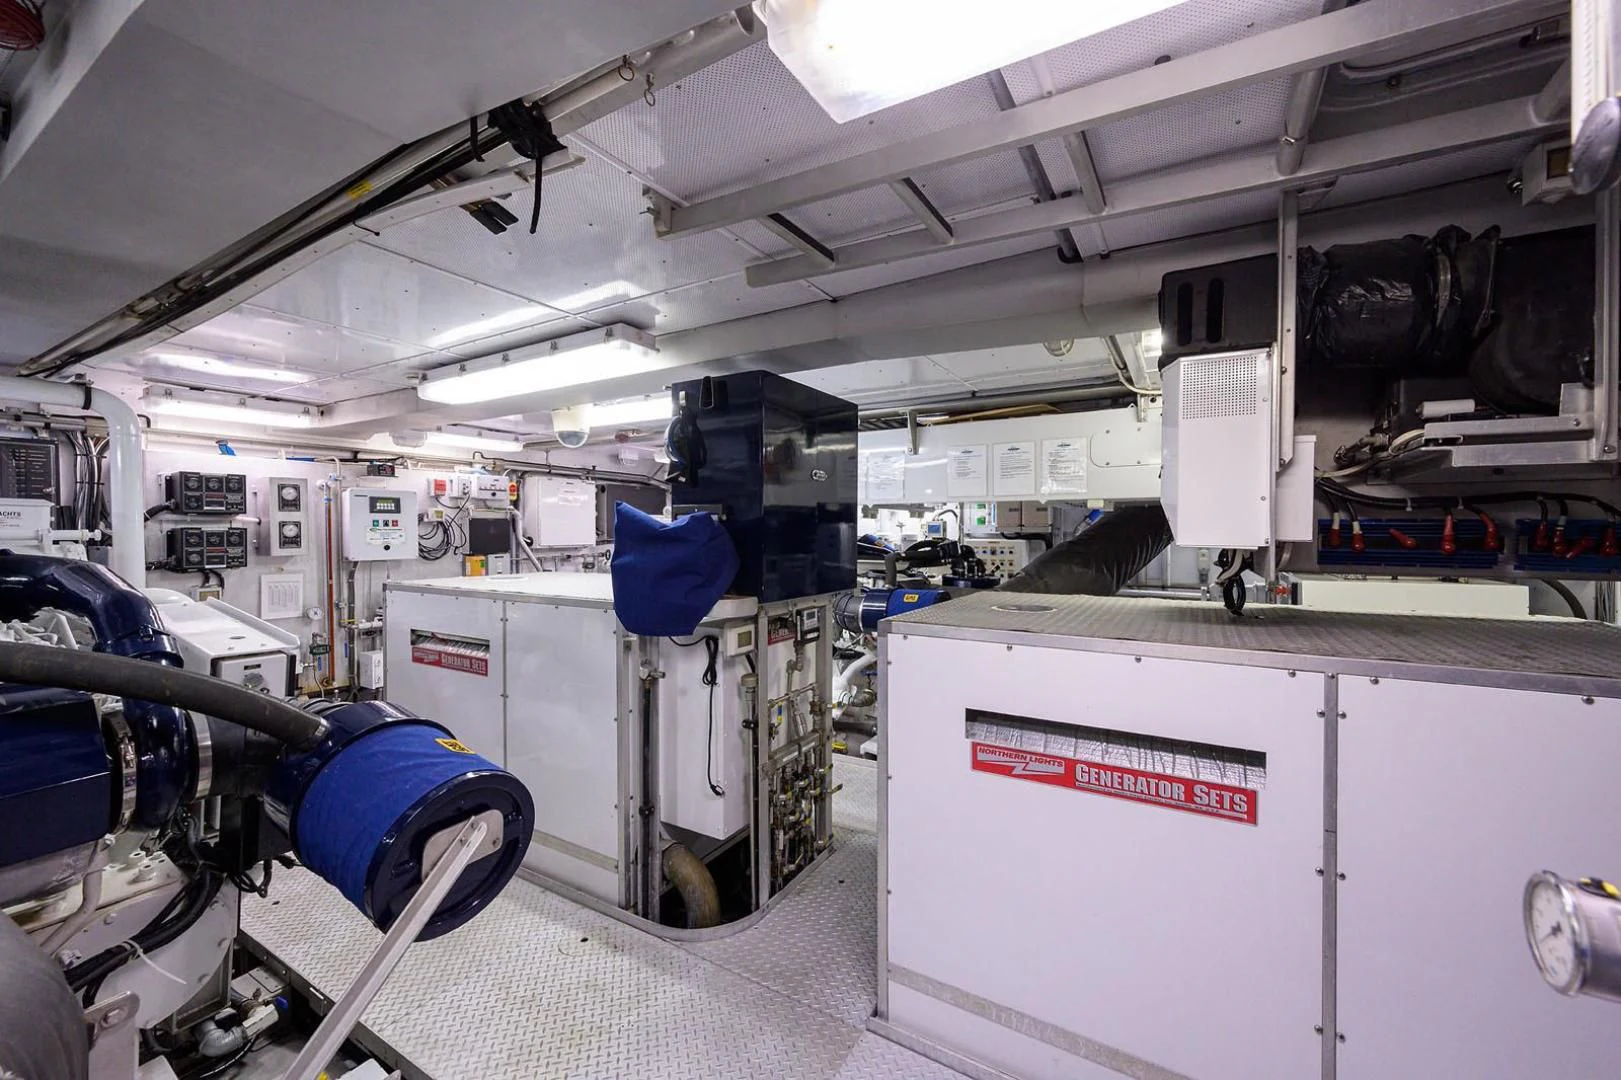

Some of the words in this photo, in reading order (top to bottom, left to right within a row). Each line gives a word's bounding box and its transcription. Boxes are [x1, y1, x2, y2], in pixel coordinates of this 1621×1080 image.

[978, 747, 1028, 762] NORTHERN
[1029, 756, 1064, 768] LIGHTS
[1075, 763, 1185, 801] GENERATOR
[1193, 784, 1248, 813] SETS
